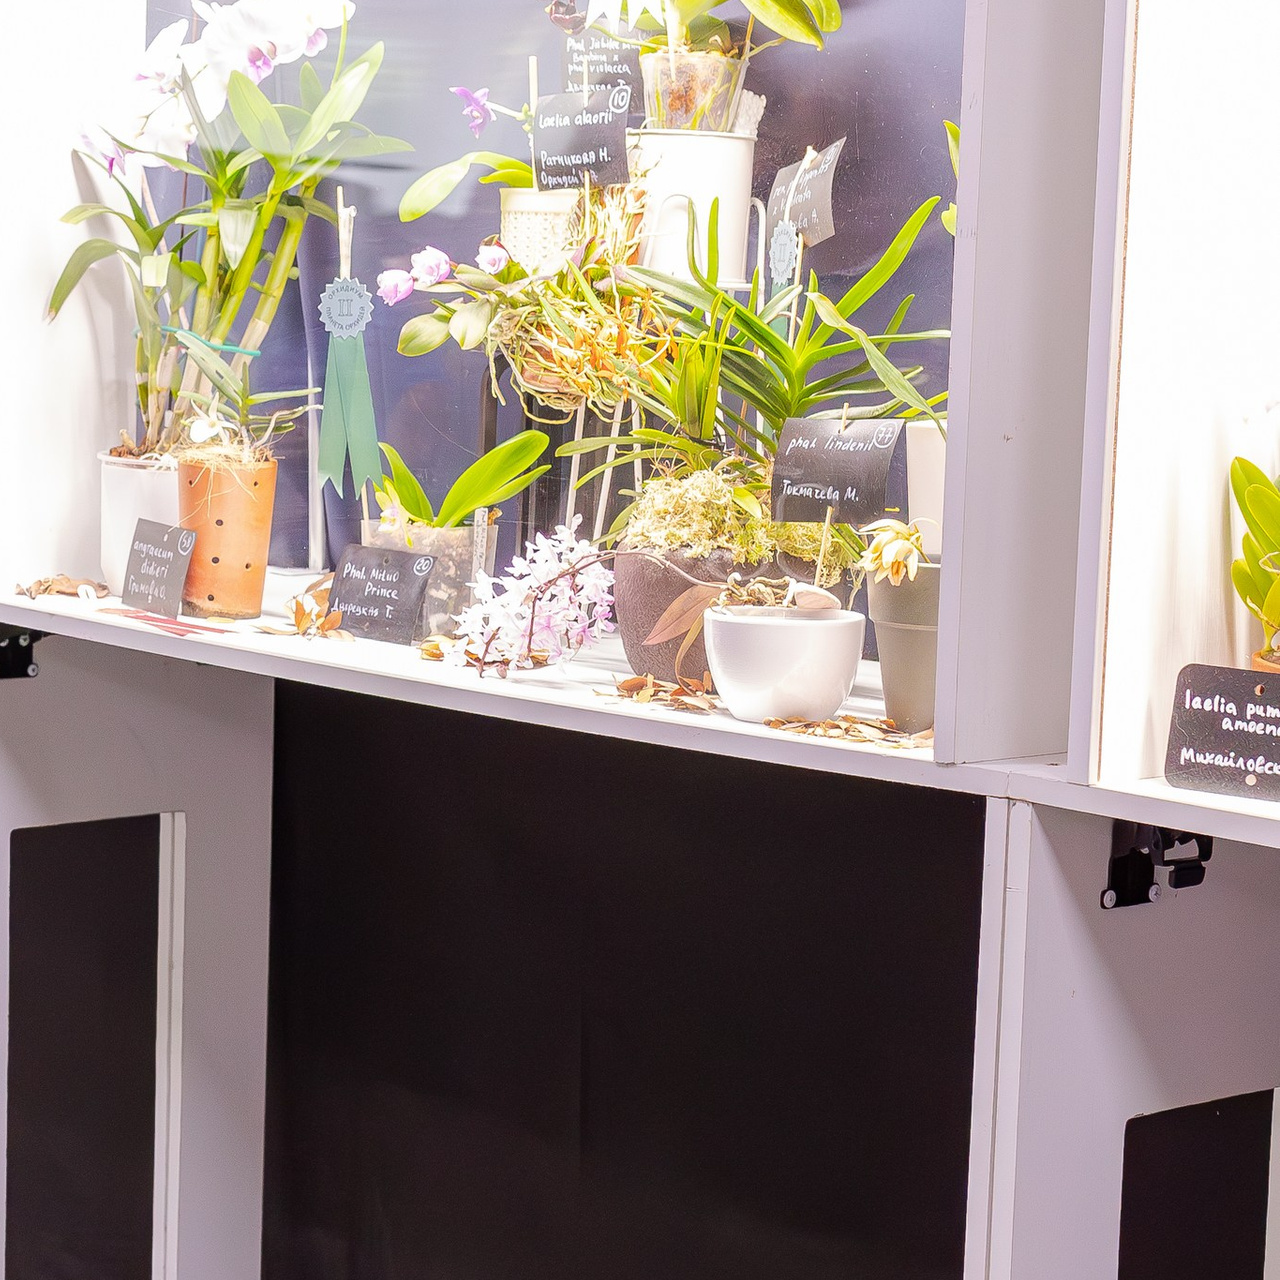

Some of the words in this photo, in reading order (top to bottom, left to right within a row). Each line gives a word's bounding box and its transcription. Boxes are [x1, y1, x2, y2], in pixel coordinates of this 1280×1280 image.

[611, 88, 629, 110] 10
[328, 285, 364, 300] ОРХИДИУМ
[338, 299, 353, 317] II
[326, 306, 344, 331] ПЛАНЕТА
[345, 306, 366, 331] ОРХИДЕЙ
[875, 425, 895, 445] 77
[782, 480, 840, 501] Токмачева
[844, 486, 859, 502] М.
[415, 558, 432, 574] 20
[364, 582, 399, 600] Prince
[1185, 688, 1238, 716] laelia
